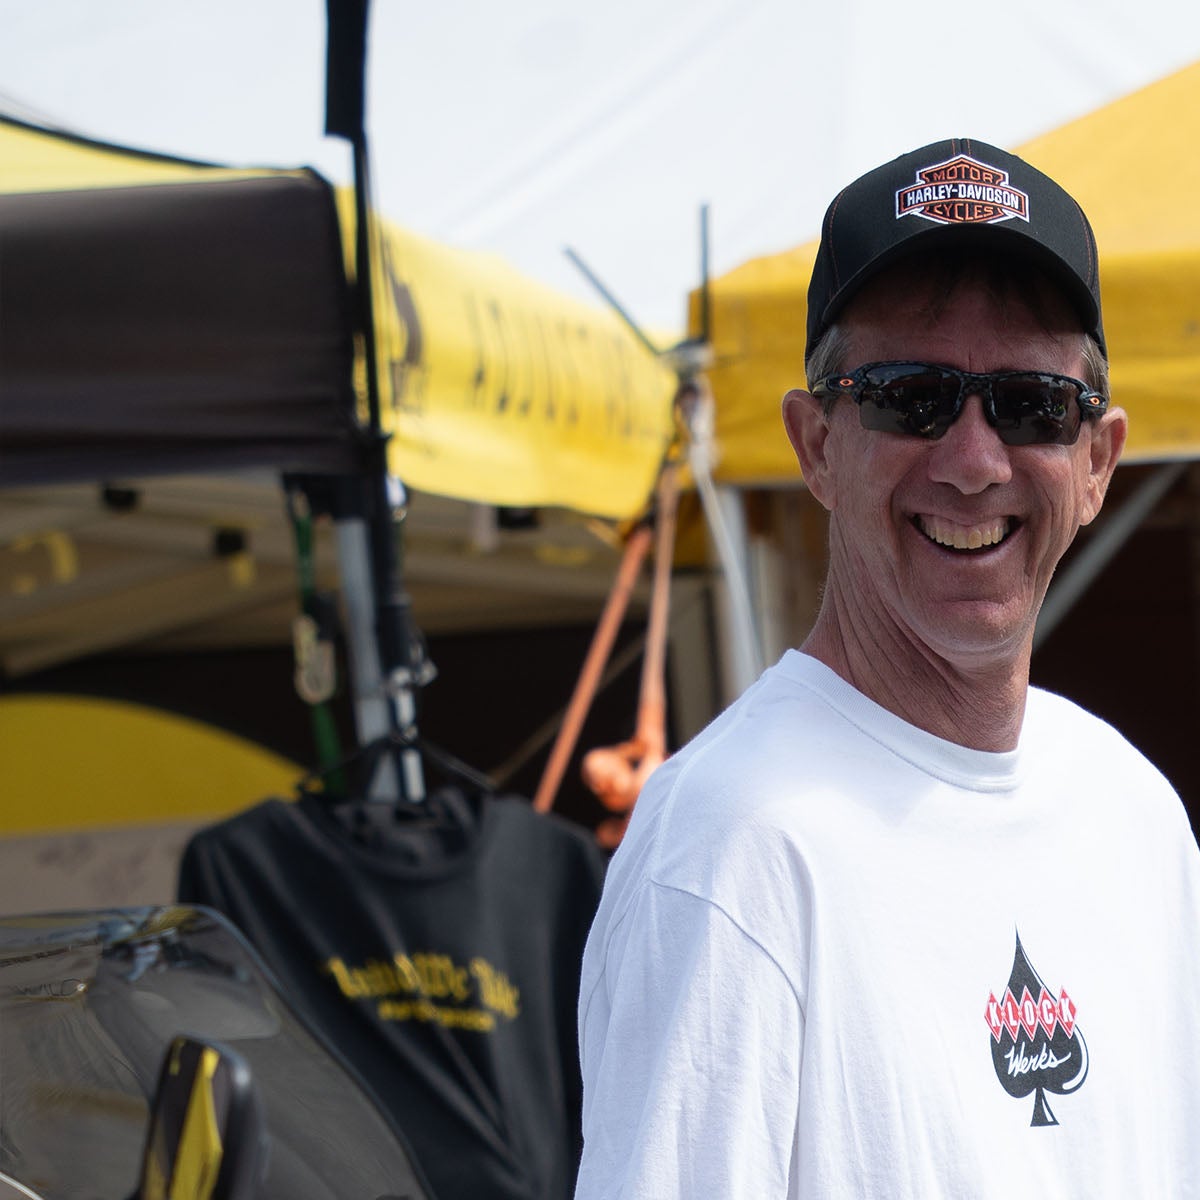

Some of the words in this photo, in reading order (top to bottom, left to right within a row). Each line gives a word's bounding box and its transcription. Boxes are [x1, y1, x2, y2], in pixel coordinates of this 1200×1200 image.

[933, 164, 994, 183] MOTOR
[907, 183, 1019, 209] HARLEY-DAVIDSON
[934, 203, 994, 220] CYCLES
[989, 998, 1074, 1027] KLOCK
[1004, 1041, 1072, 1077] Werks
